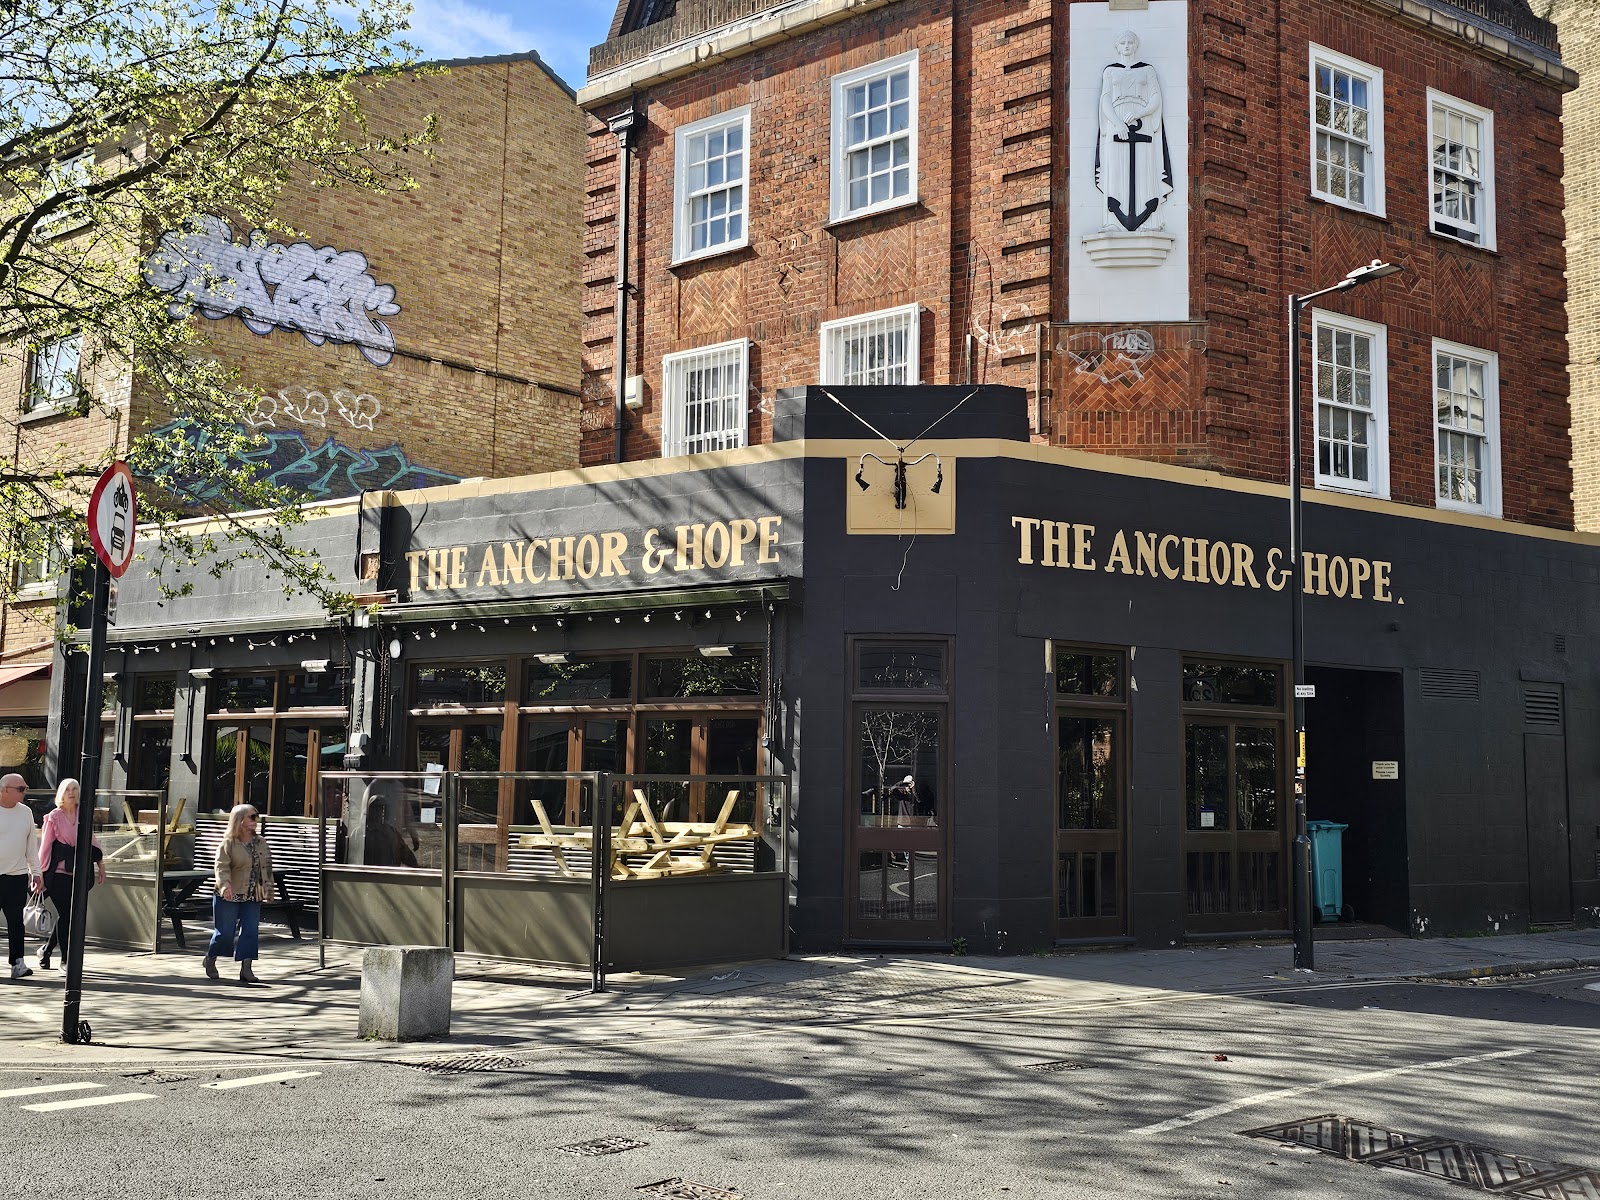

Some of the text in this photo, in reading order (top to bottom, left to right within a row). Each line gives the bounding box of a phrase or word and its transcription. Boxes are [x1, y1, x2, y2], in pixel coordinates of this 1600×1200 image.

[405, 546, 468, 592] THE
[476, 532, 630, 587] ANCHOR
[1011, 516, 1096, 571] THE
[1104, 529, 1260, 589] ANCHOR
[1265, 548, 1292, 592] &
